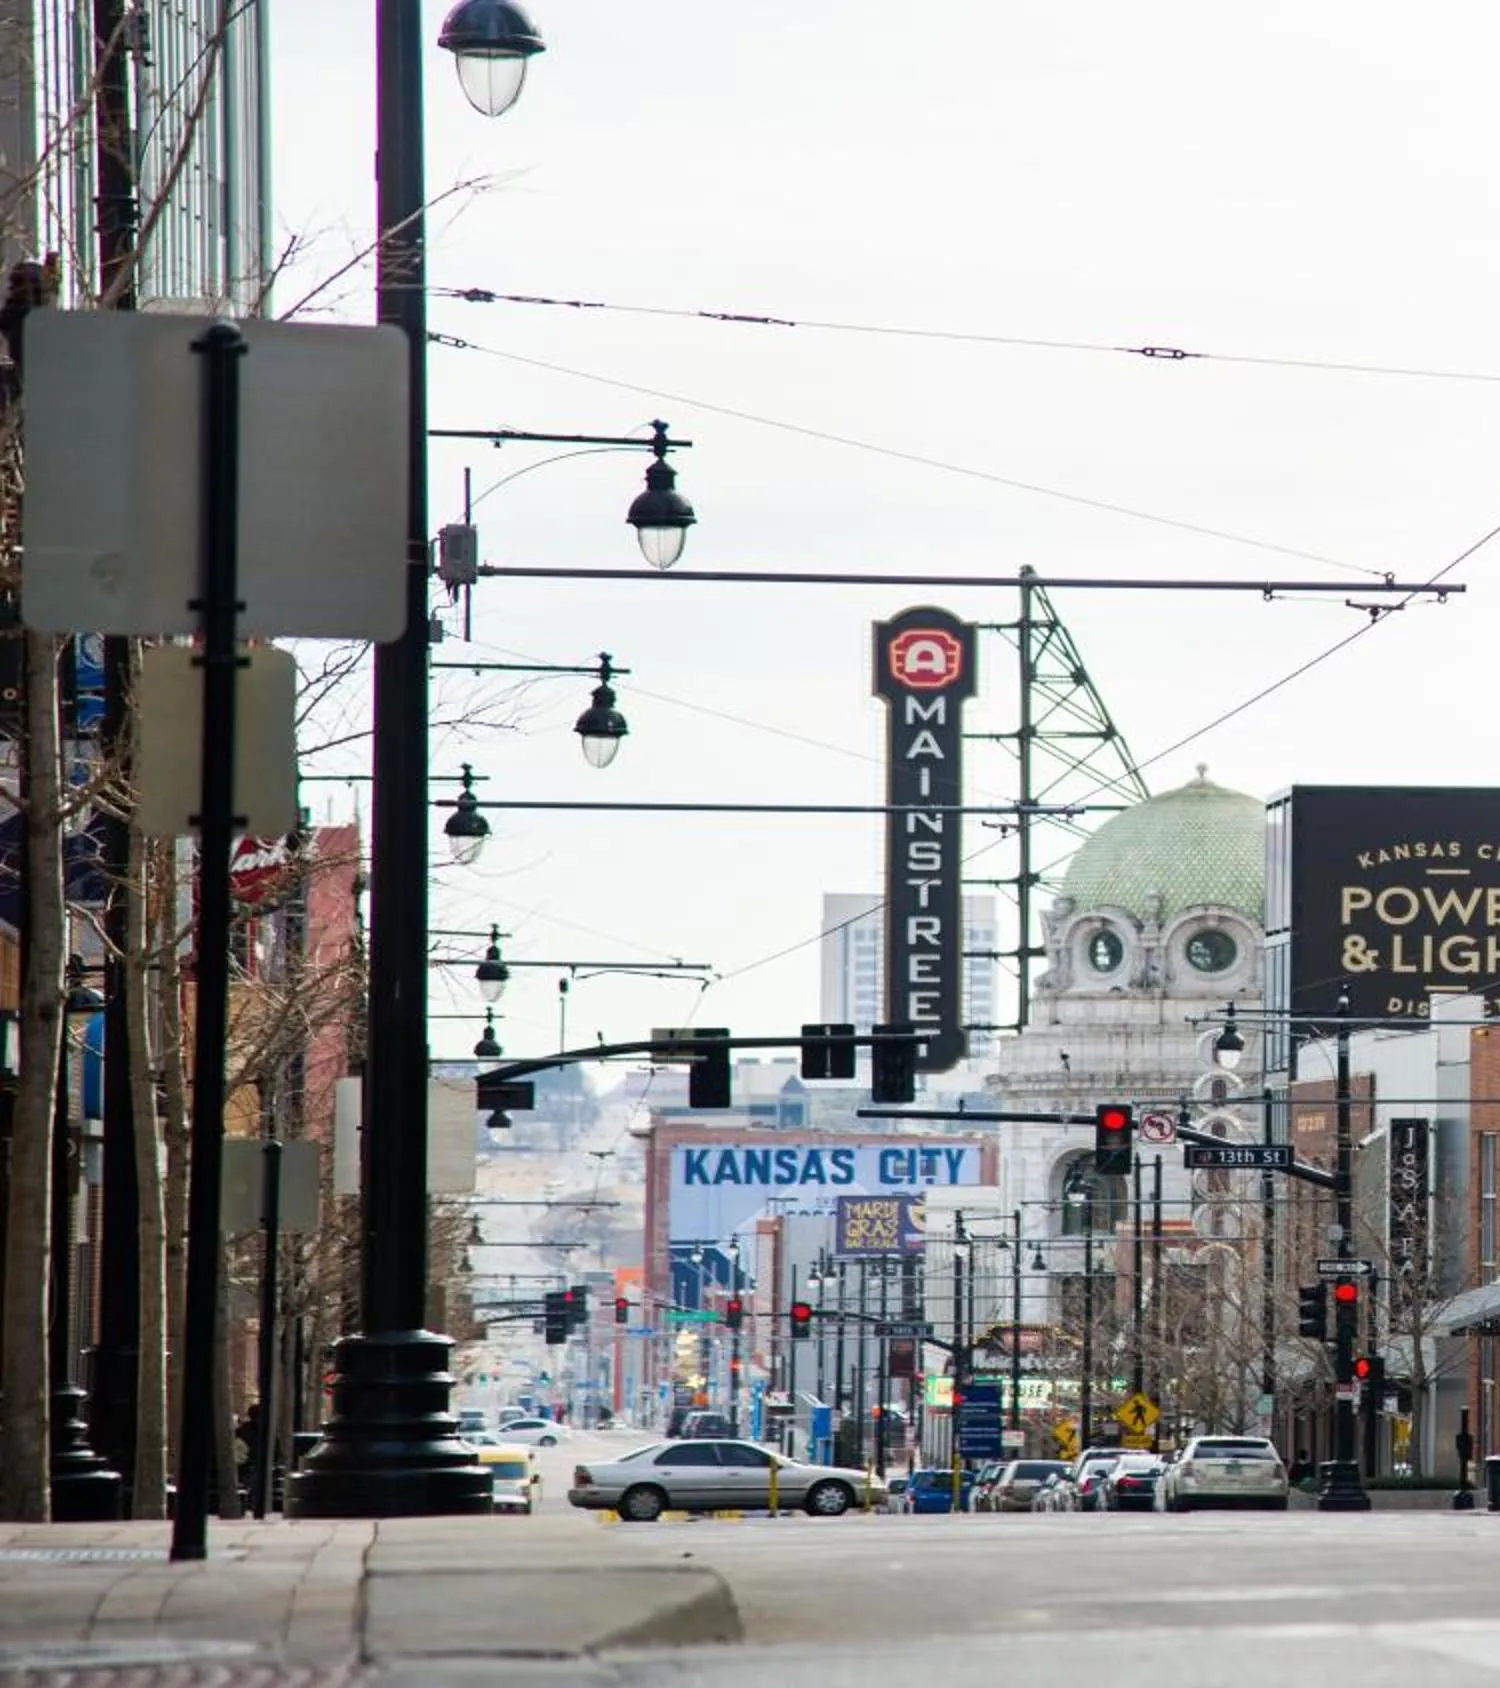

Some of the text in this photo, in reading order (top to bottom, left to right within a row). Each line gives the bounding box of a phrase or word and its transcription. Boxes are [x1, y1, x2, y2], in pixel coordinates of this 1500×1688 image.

[1356, 842, 1462, 869] KANSAS
[1341, 934, 1379, 973] &
[684, 1148, 967, 1186] KANSAS CITY
[1219, 1150, 1281, 1163] 13th St
[847, 1219, 898, 1237] GRAS
